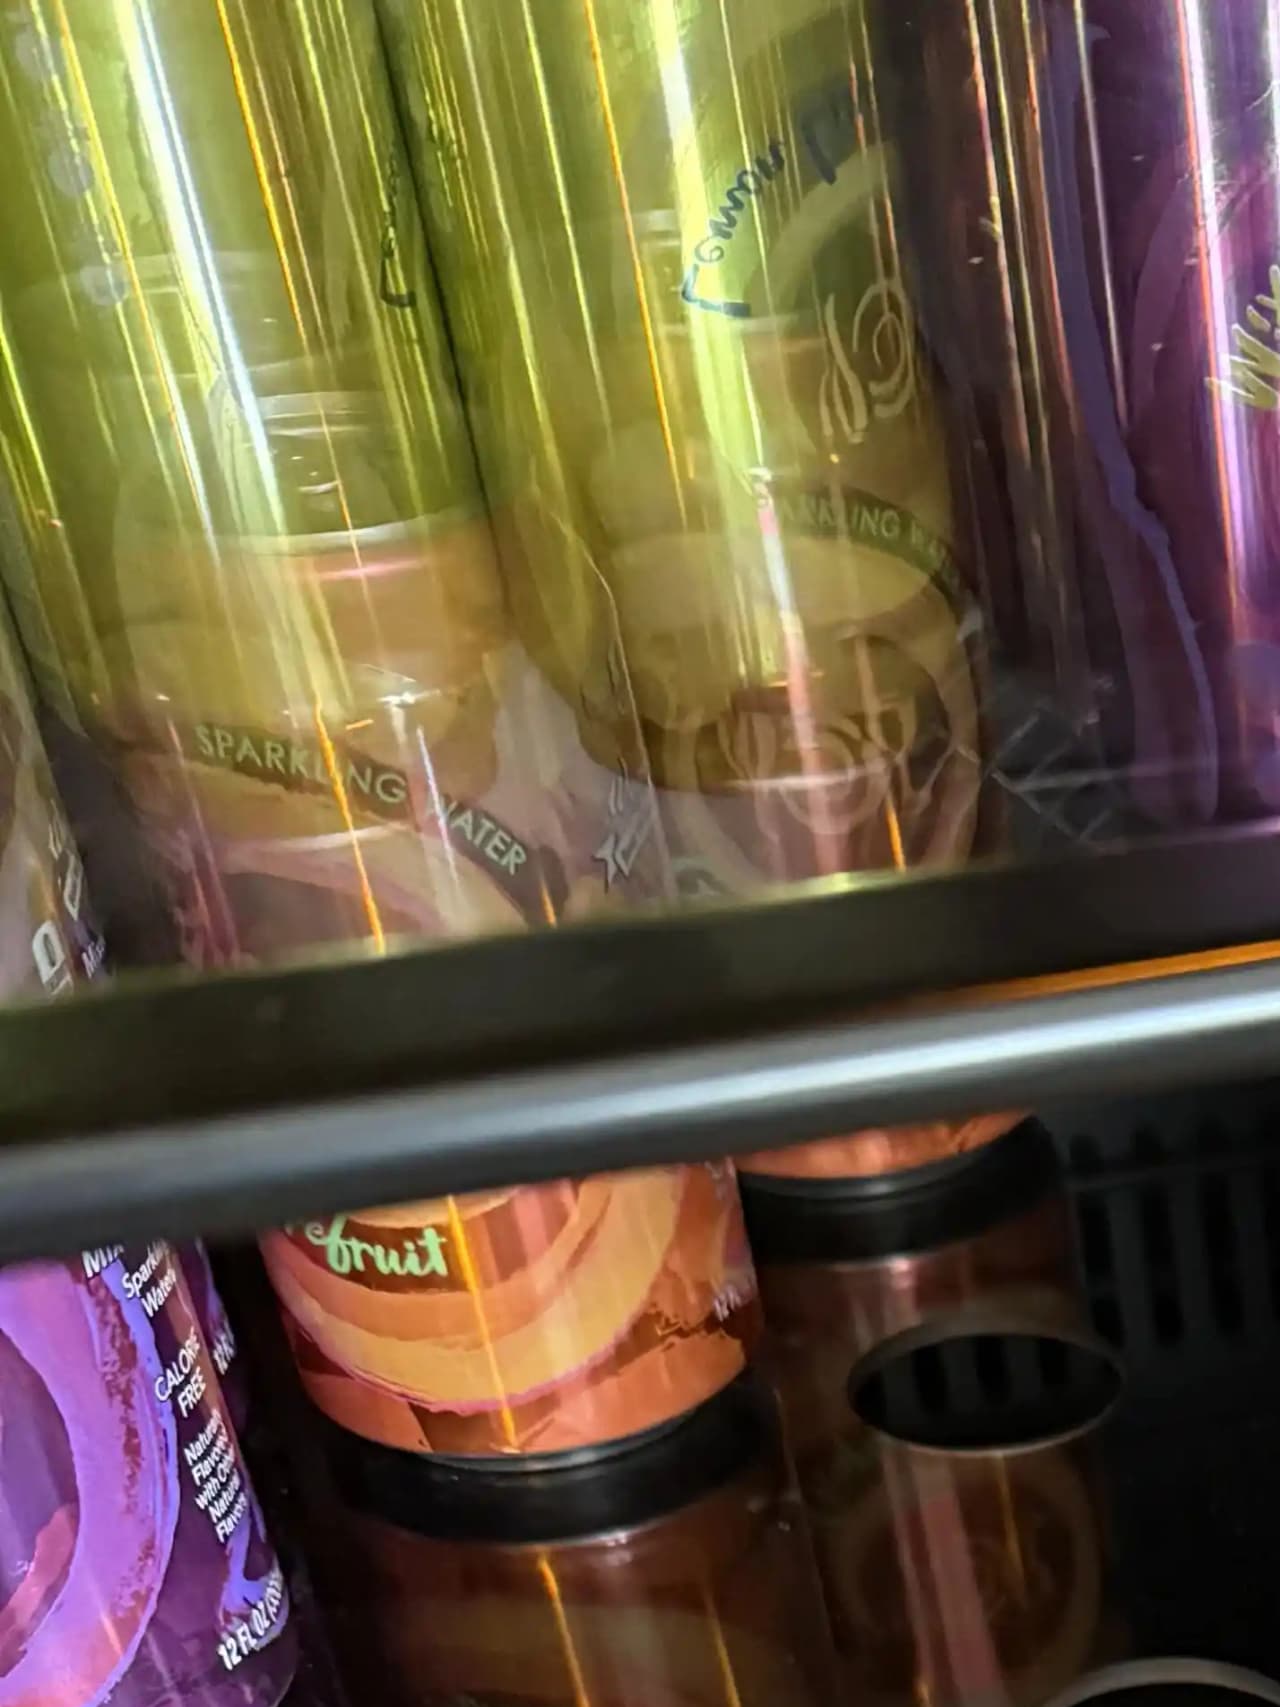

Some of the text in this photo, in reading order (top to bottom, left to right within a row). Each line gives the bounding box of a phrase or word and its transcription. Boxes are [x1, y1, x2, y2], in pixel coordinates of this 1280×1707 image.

[194, 724, 408, 804] SPARKLNG
[217, 1632, 242, 1671] 12
[236, 1621, 258, 1656] FL
